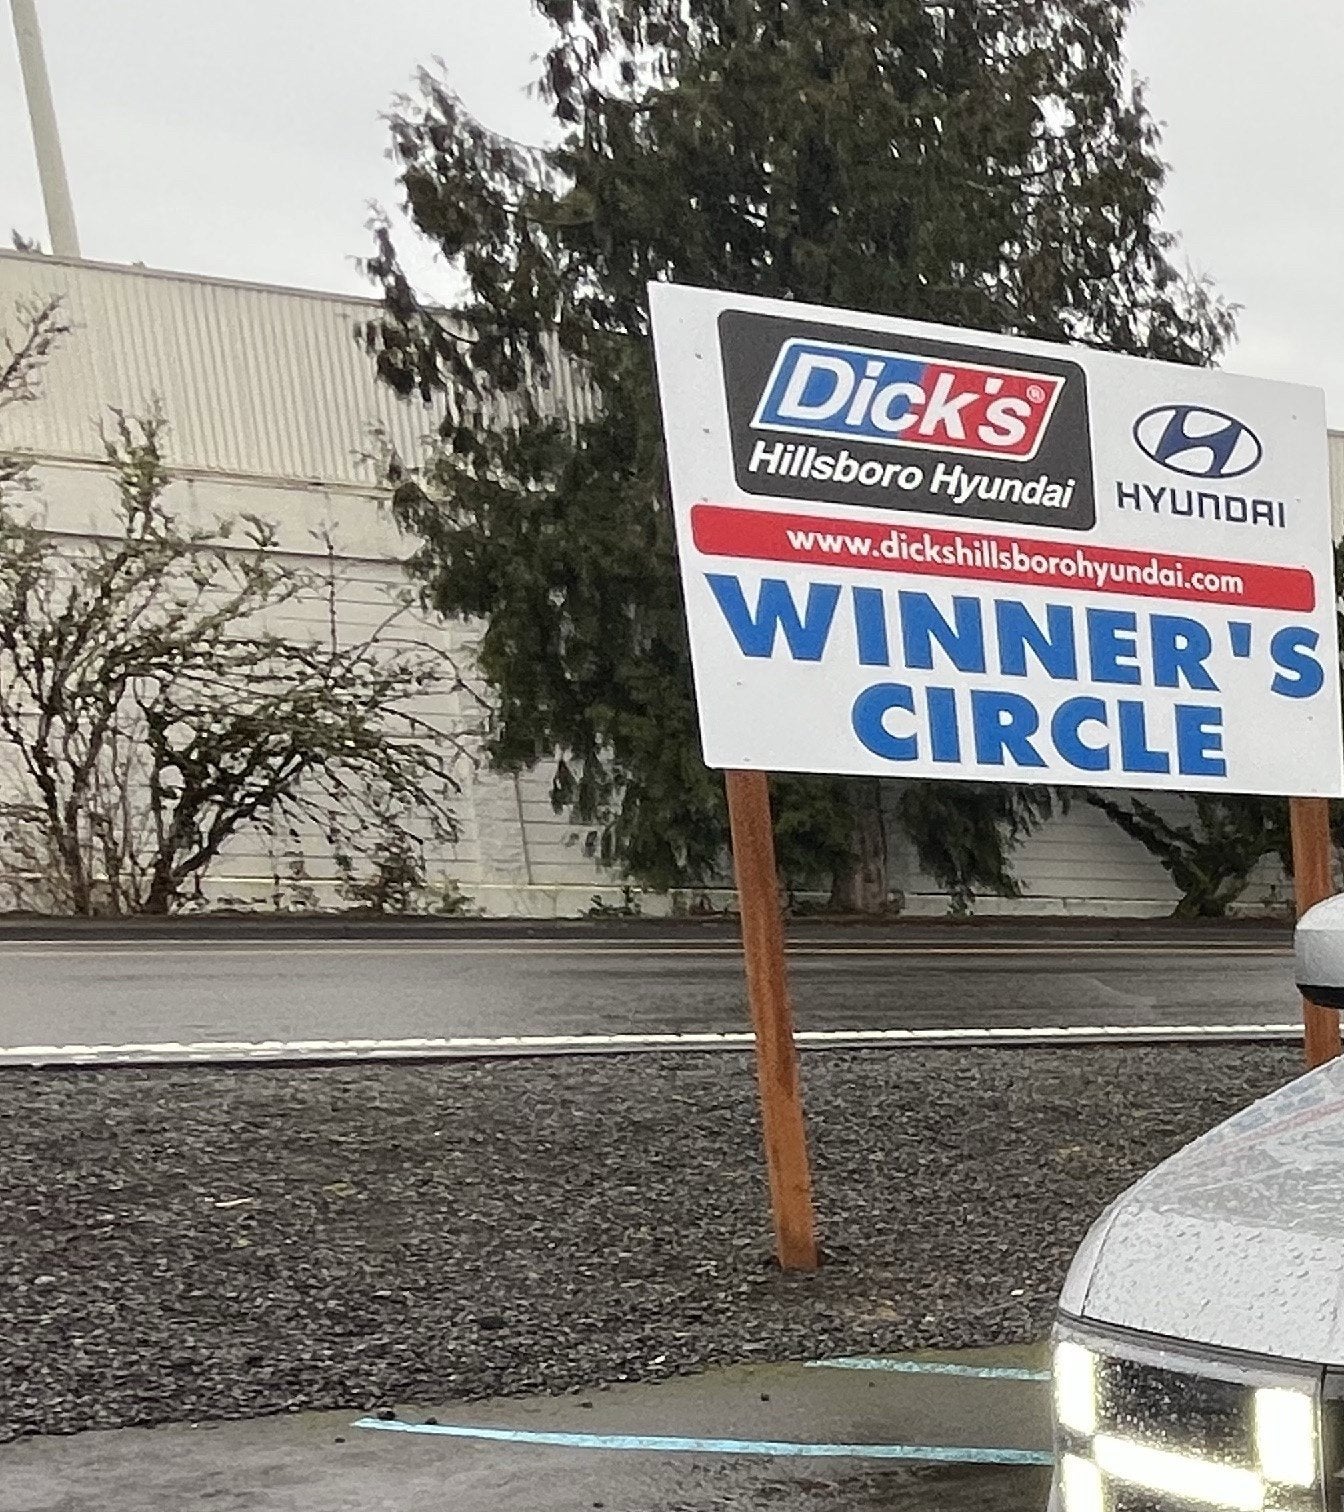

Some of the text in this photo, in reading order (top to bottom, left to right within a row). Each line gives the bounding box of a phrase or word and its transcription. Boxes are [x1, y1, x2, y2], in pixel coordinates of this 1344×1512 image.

[777, 352, 1033, 447] Dick's
[748, 440, 1076, 509] Hillsboro Hyundai
[1116, 482, 1285, 528] HYUNDAI
[787, 526, 1244, 595] www.dickshillsborohyundai.com
[705, 573, 1325, 698] WINNER'S
[852, 683, 1228, 778] CIRCLE
